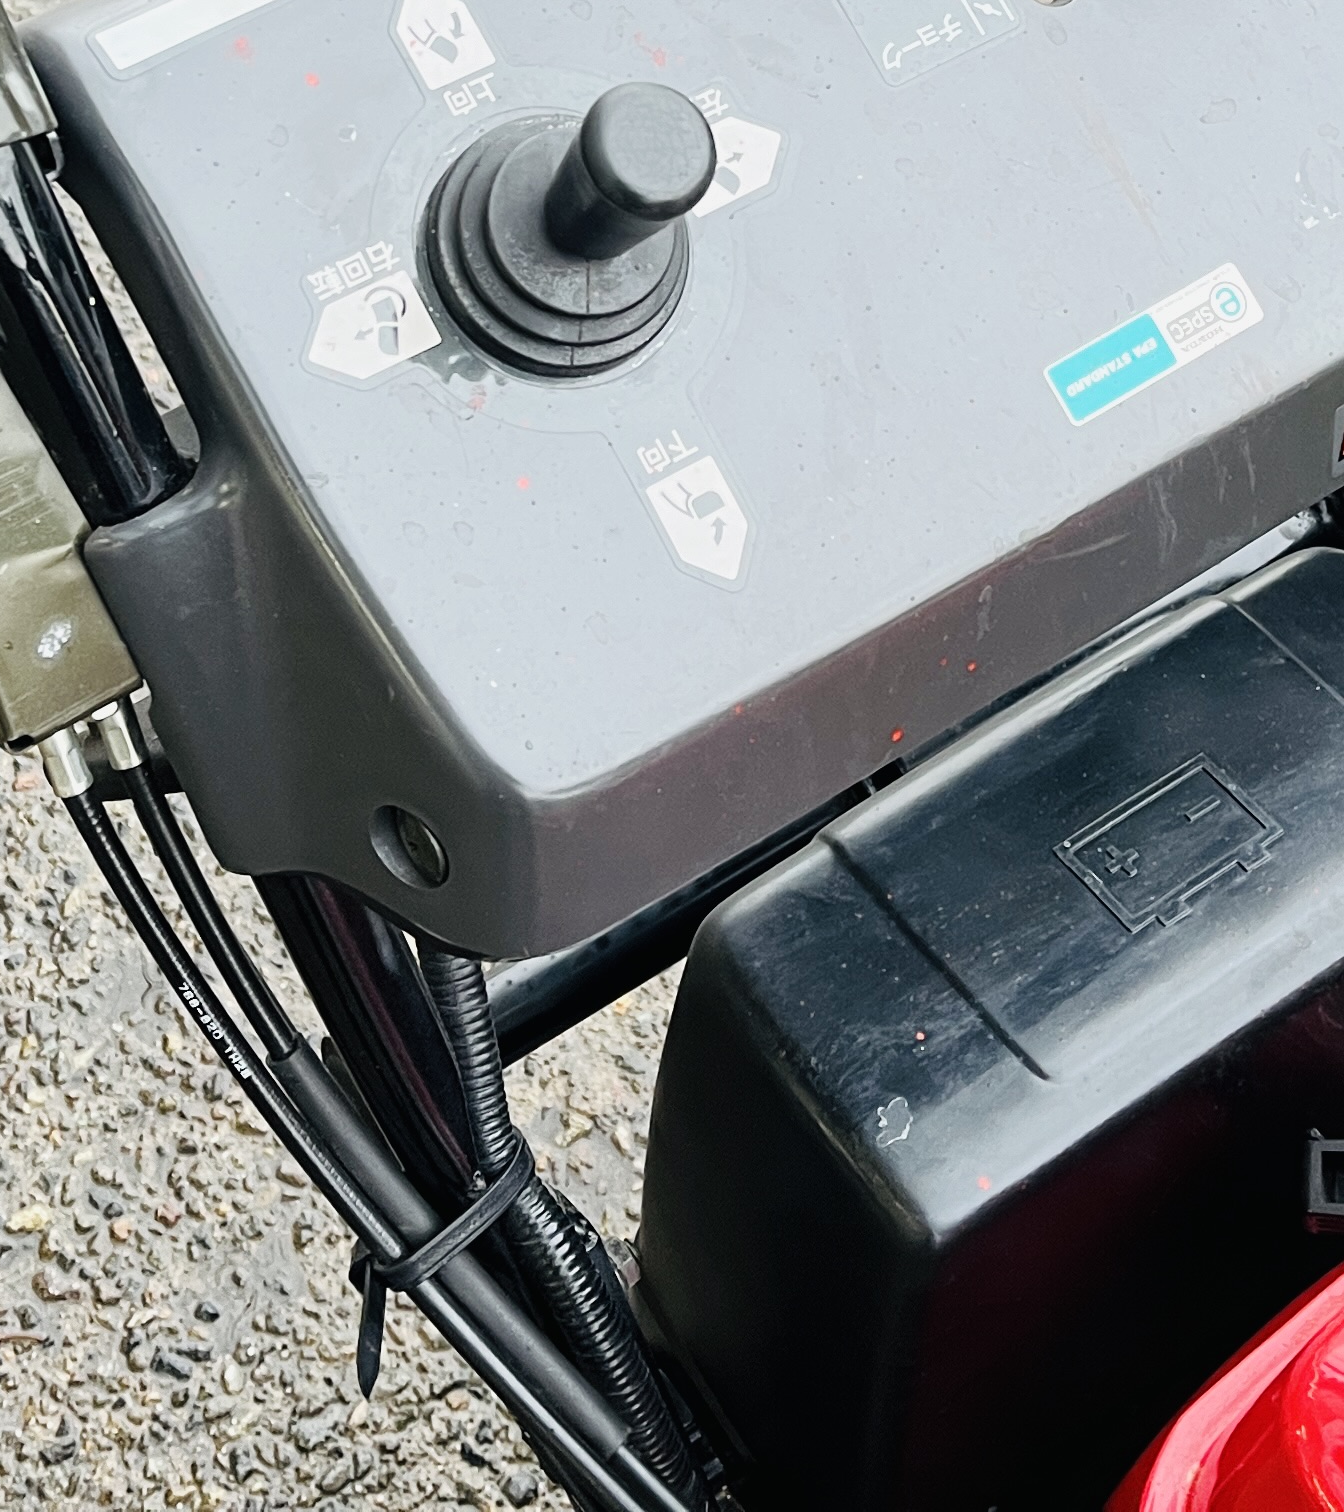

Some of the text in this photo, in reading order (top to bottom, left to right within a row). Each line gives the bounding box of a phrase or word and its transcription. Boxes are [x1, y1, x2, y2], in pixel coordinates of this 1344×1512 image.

[882, 13, 964, 71] チョーク
[442, 72, 497, 117] 上向
[307, 240, 401, 302] 右回転
[1169, 306, 1215, 341] SPEC
[1181, 325, 1225, 352] HONDA
[1066, 337, 1159, 398] EPA STANDARD
[636, 429, 699, 474] 下向
